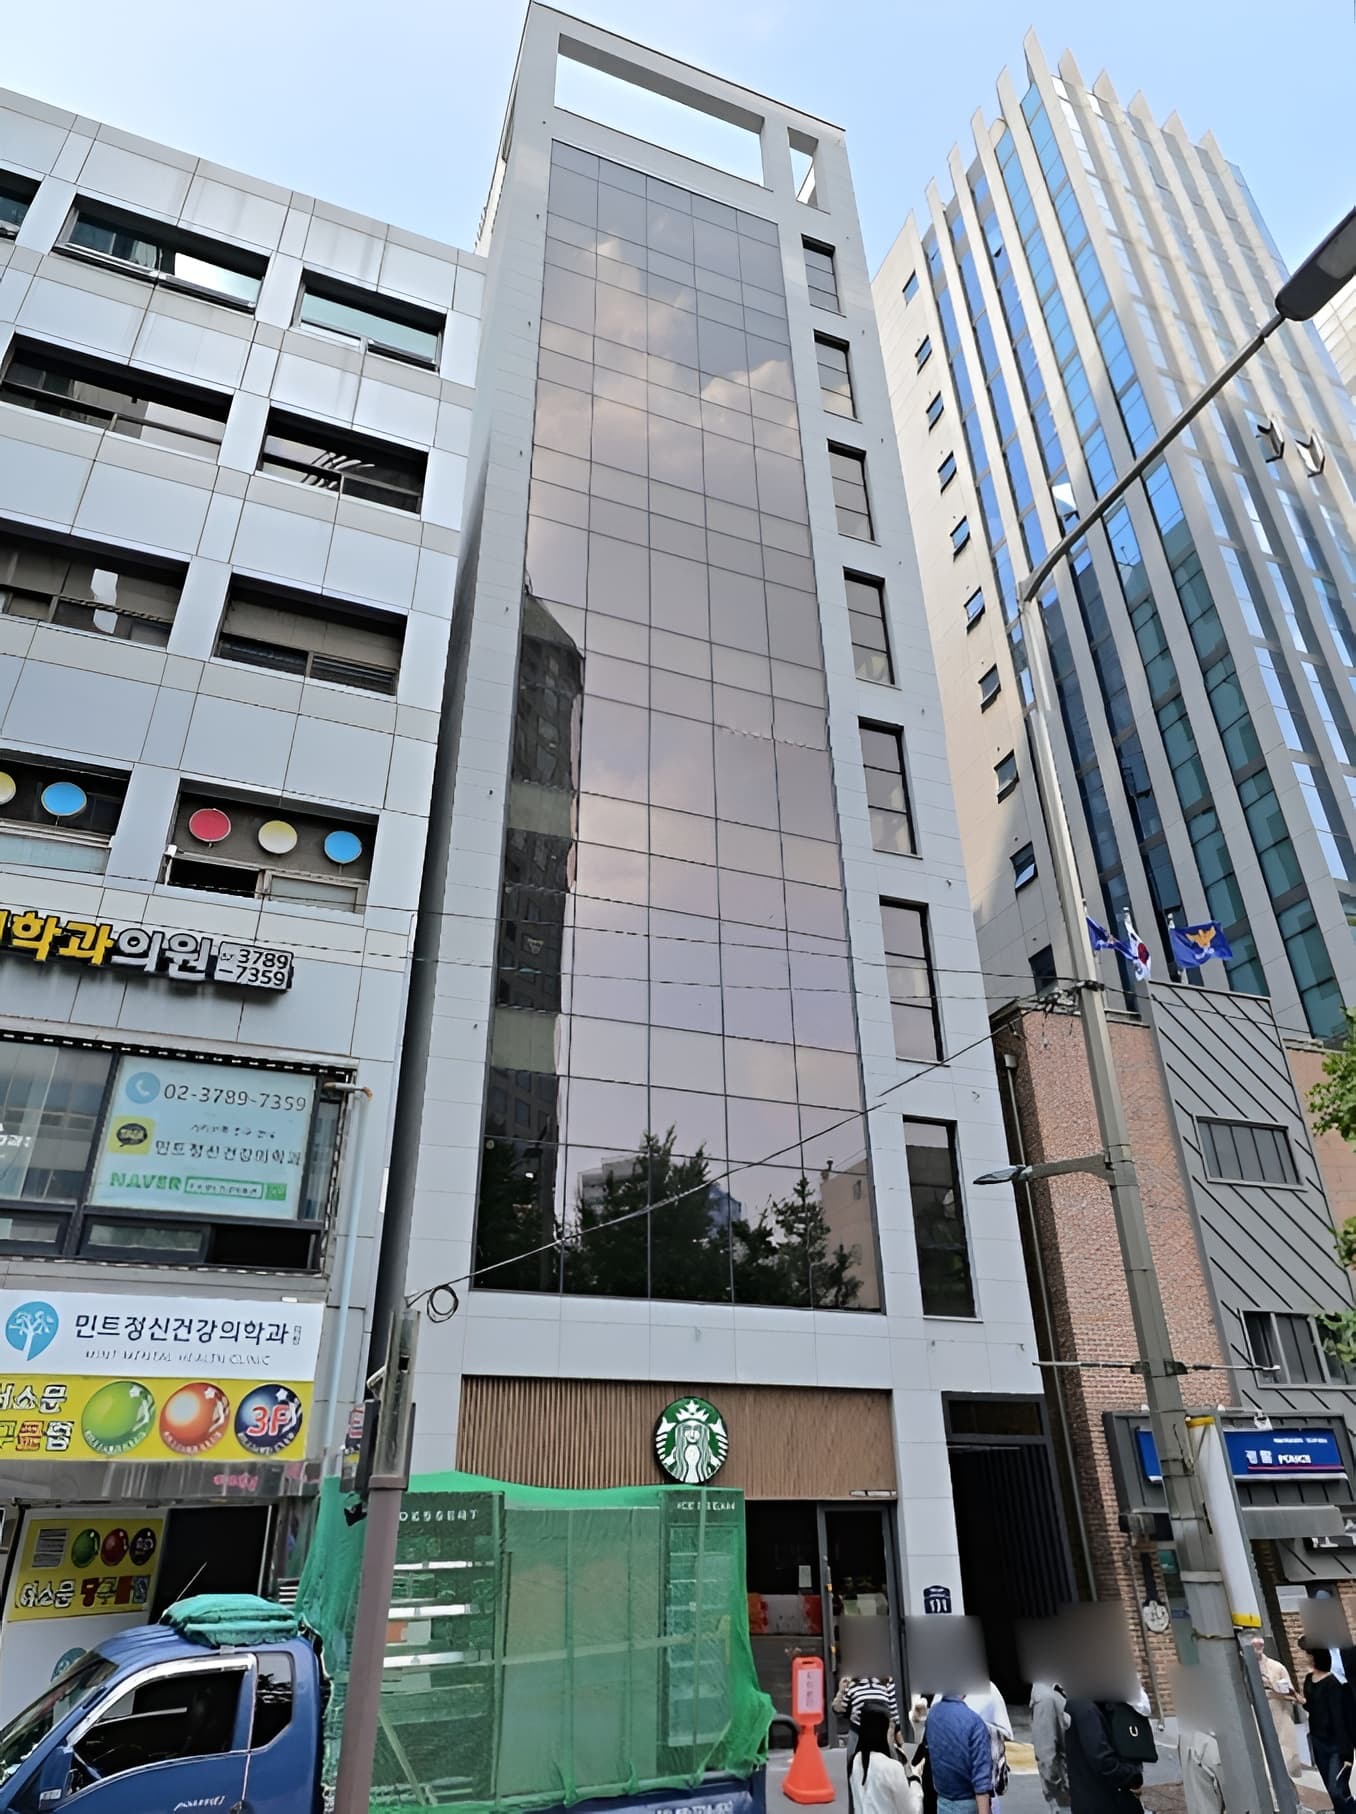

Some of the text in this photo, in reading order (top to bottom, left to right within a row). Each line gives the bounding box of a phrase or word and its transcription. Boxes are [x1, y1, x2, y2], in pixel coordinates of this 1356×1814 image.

[238, 949, 289, 969] 3789
[164, 1084, 306, 1112] 02-3789-7359
[110, 1172, 182, 1190] NAVER
[75, 1314, 289, 1345] 민트정신건강의학과
[247, 1404, 290, 1437] 3F
